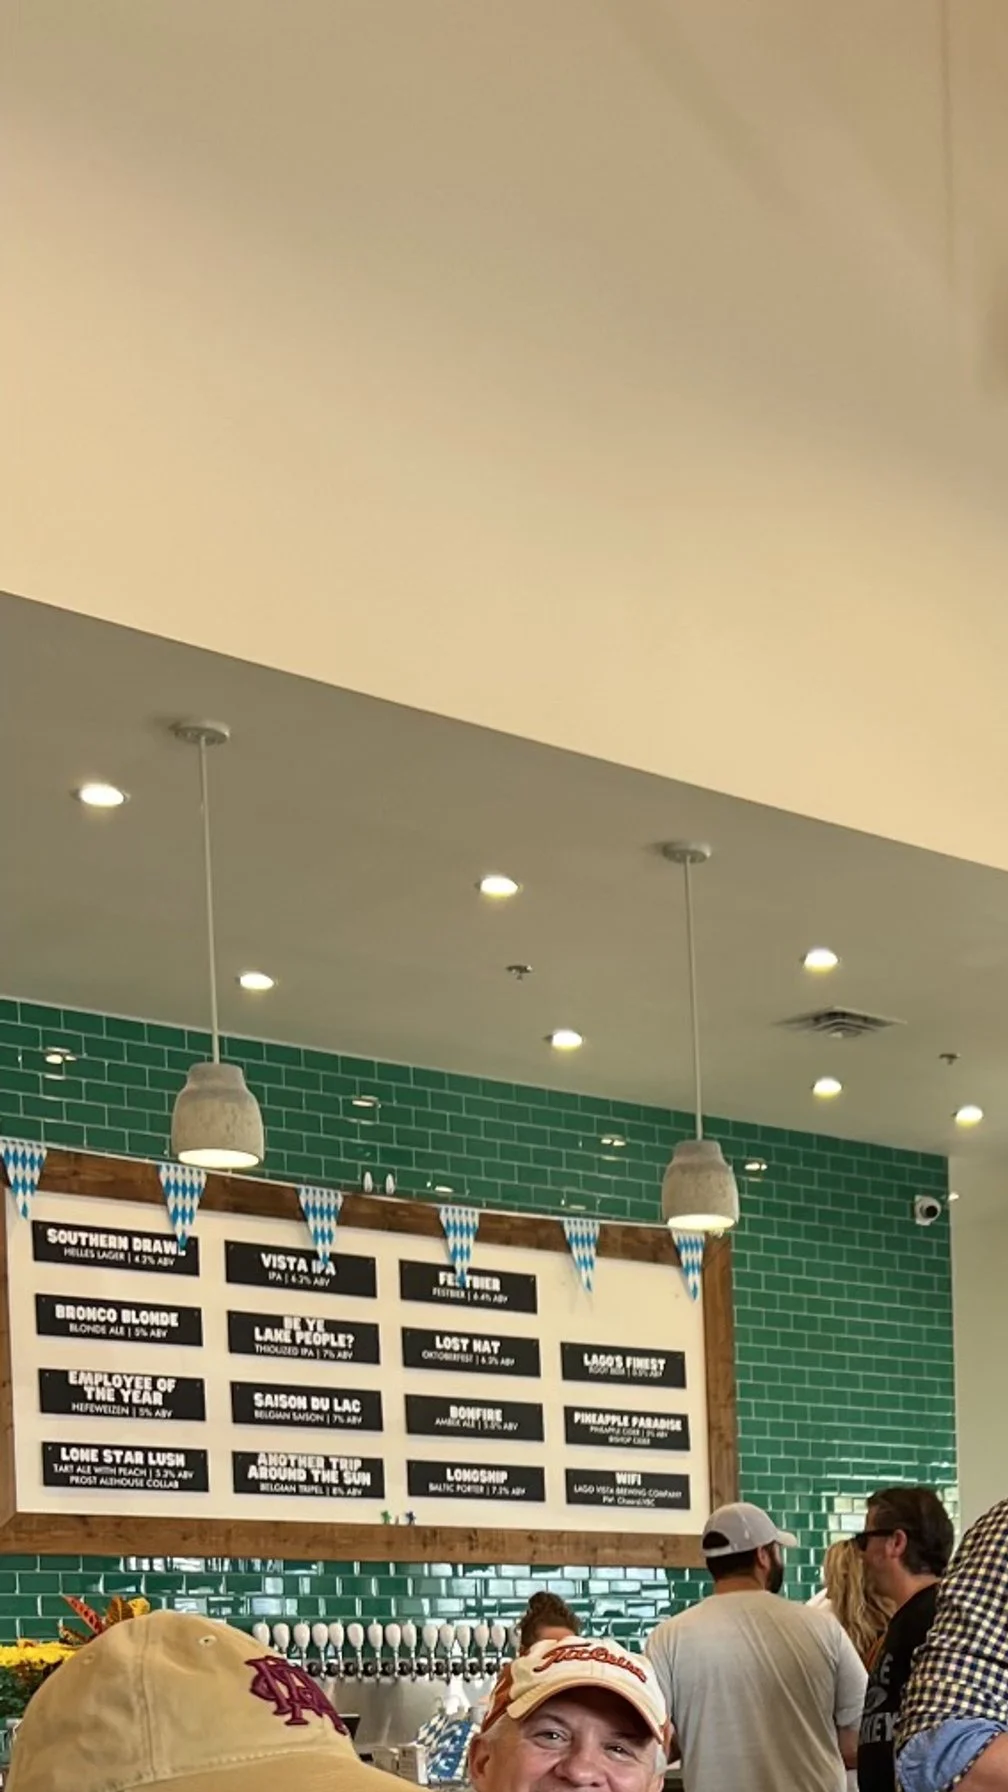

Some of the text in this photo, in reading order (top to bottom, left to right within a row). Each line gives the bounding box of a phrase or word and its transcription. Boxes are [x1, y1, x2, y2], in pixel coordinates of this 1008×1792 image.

[47, 1228, 128, 1251] SOUTHERN
[64, 1248, 95, 1259] HELLES
[97, 1250, 125, 1261] LAGER
[157, 1257, 175, 1267] ABV
[260, 1252, 308, 1274] VISTA
[268, 1272, 282, 1282] IPA
[313, 1277, 331, 1287] ABV
[439, 1271, 501, 1292] FETBIER
[492, 1294, 509, 1304] ABV
[55, 1304, 179, 1327] BRONCO BLONDE
[69, 1323, 169, 1338] BLONDE ALE 5% ABV
[283, 1316, 325, 1333] BE YE
[254, 1326, 355, 1349] LAKE PEOPLE?
[435, 1335, 501, 1355] LOST HAT
[300, 1347, 314, 1357] IPA
[323, 1349, 336, 1359] 7%
[336, 1350, 353, 1360] ABV
[500, 1357, 516, 1367] ABV
[583, 1352, 666, 1371] LAGO'S FINEST
[68, 1370, 177, 1393] EMPLOYEE OF
[83, 1386, 164, 1406] THE YEAR
[253, 1392, 362, 1414] SAISON DU LAC
[72, 1402, 130, 1415] HEFEWEIZEN
[154, 1409, 173, 1419] ABV
[254, 1410, 363, 1425] BELGIAN SAISON 7% ABV
[449, 1404, 503, 1422] BONFIRE
[503, 1422, 520, 1432] ABV
[574, 1411, 682, 1432] PINEAPPLE PARADISE
[60, 1447, 186, 1468] LONE STAR LUSH
[257, 1452, 362, 1472] ANOTHER TRIP
[52, 1464, 75, 1474] TART
[76, 1464, 91, 1474] ALE
[94, 1466, 116, 1476] WITH
[118, 1467, 147, 1477] PEACH
[178, 1470, 195, 1480] ABV
[247, 1465, 372, 1487] AROUND THE SUN
[446, 1467, 508, 1484] LONGSHIP
[614, 1471, 642, 1486] WIFI
[70, 1475, 179, 1490] PROST ALEHOUSE COLLAB
[259, 1482, 297, 1494] BELGIAN
[345, 1487, 363, 1497] ABV
[510, 1486, 526, 1496] ABV
[574, 1484, 595, 1494] LAGO
